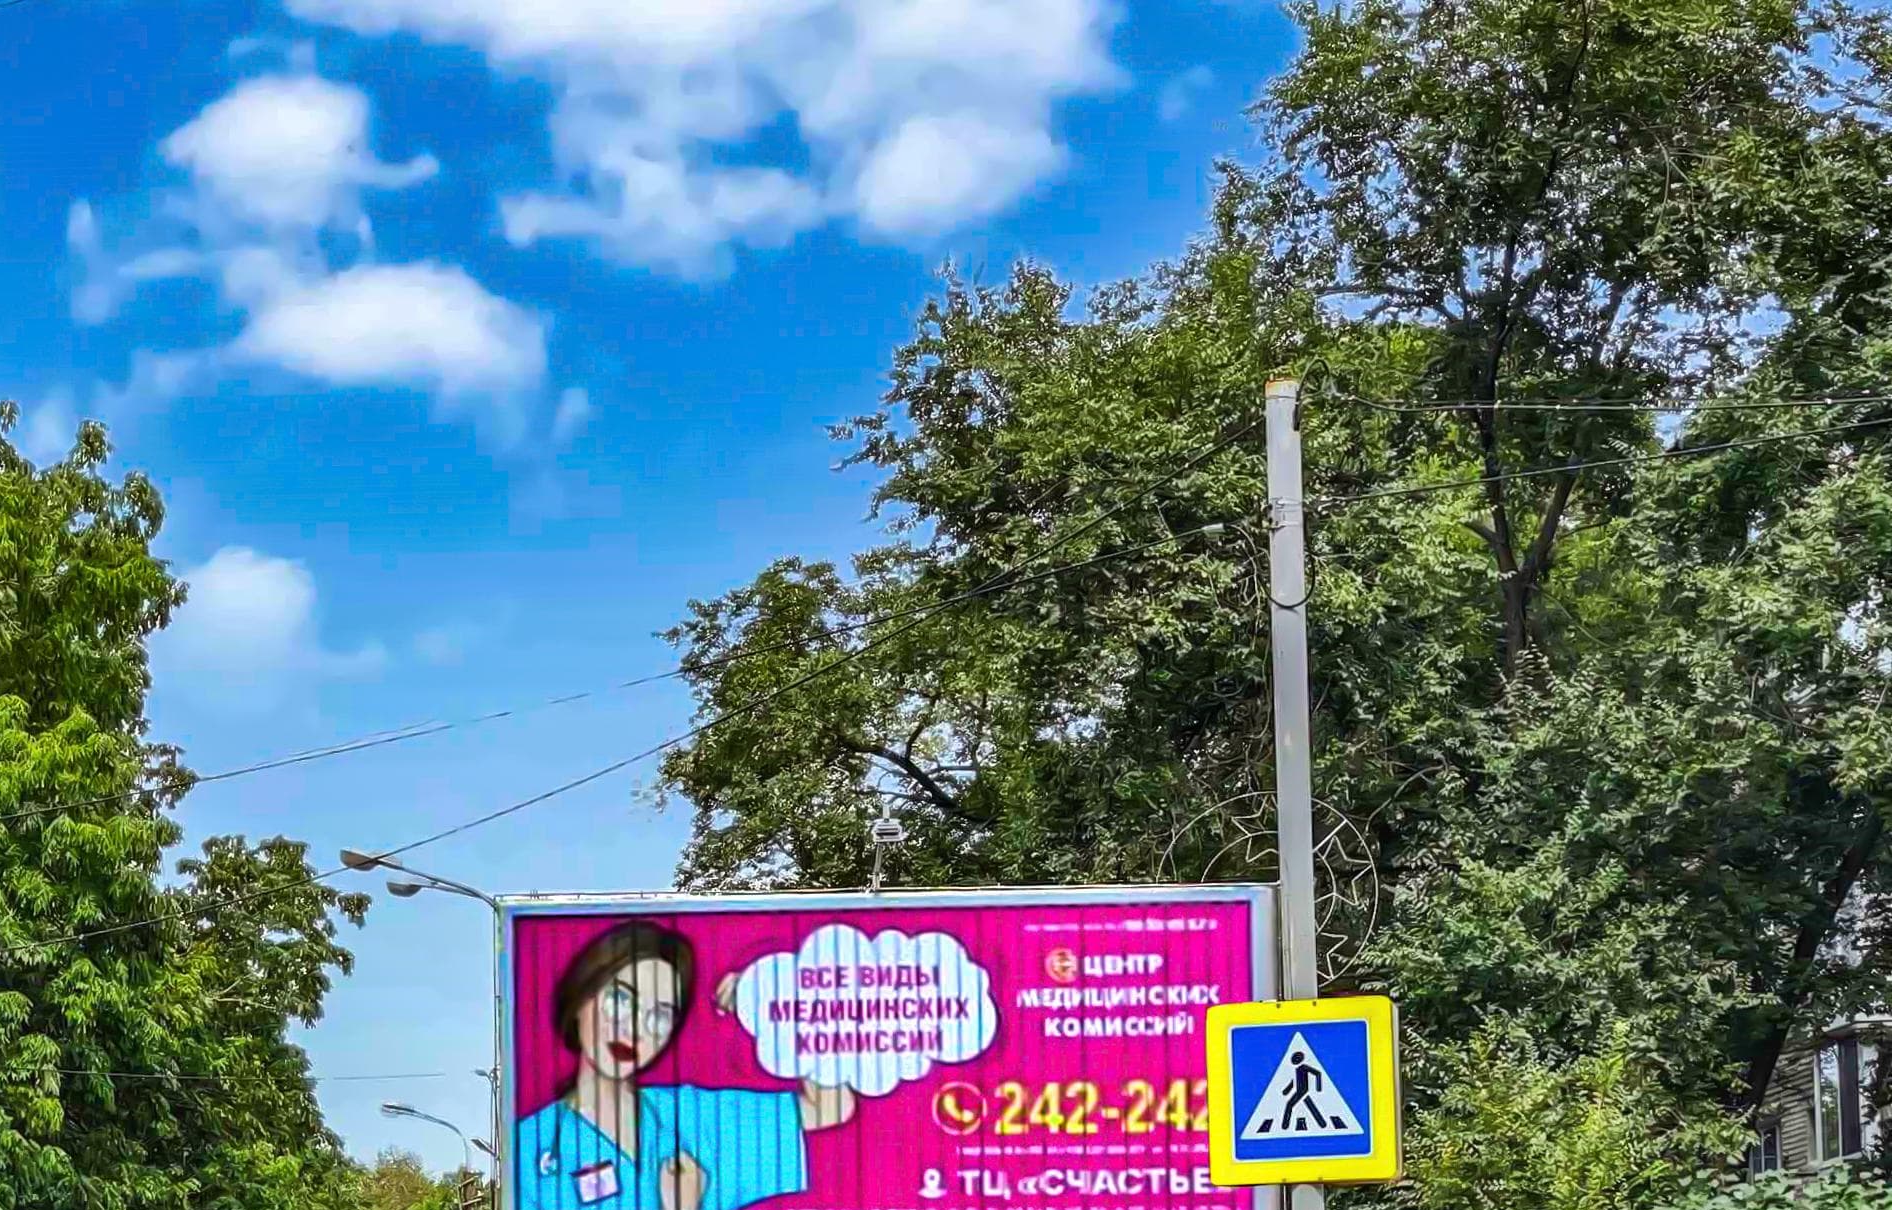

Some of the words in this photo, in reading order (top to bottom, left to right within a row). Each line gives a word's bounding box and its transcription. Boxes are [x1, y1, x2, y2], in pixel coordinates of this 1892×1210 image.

[800, 966, 849, 989] ВСЕ
[860, 965, 939, 990] ВИДЫ
[769, 998, 969, 1024] МЕДИЦИНСКИХ
[1017, 985, 1220, 1011] МЕДИЦИНСКИХ
[1045, 1011, 1194, 1037] КОМИССИЙ
[957, 1169, 1011, 1200] ТЦ
[1018, 1167, 1232, 1197] «СЧАСТЬЕ
